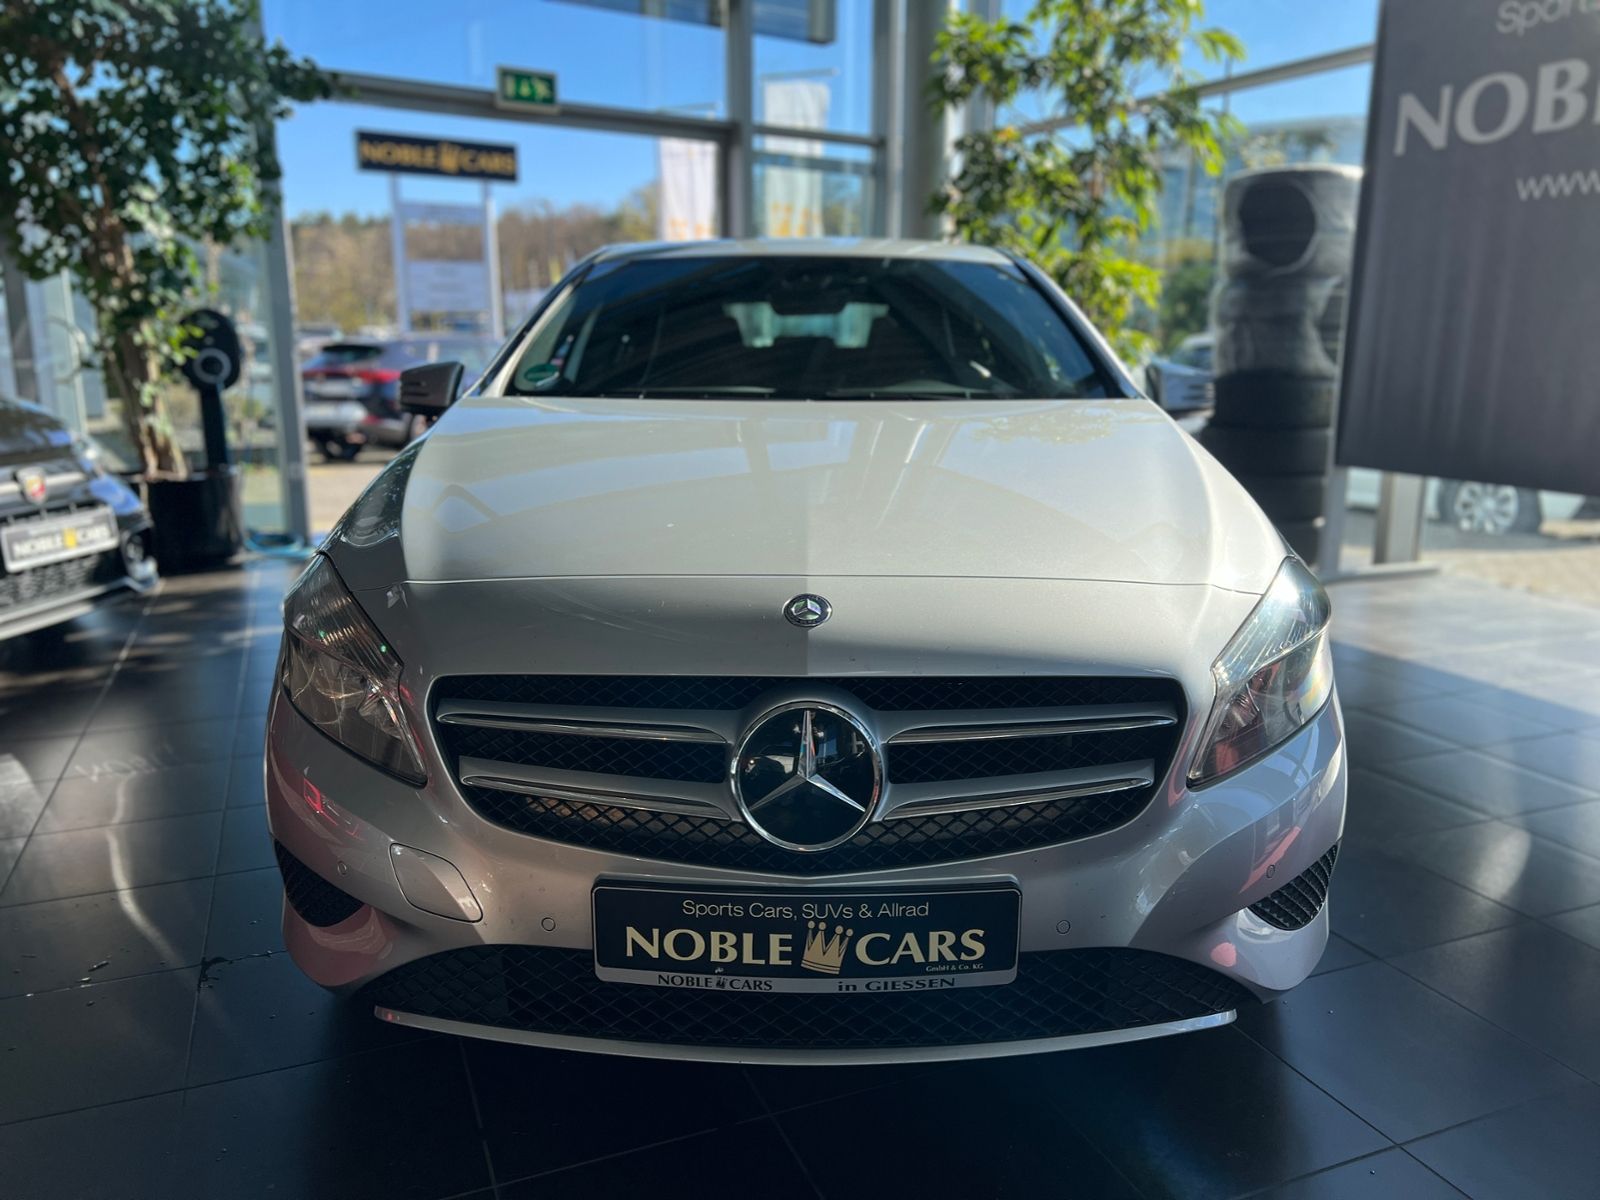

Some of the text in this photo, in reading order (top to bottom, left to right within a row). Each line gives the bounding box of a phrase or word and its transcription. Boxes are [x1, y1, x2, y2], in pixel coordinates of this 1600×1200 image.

[1394, 58, 1600, 156] NOB
[682, 900, 929, 921] Sports Cars, SUVs & Allrad
[626, 926, 986, 966] NOBLE CARS
[657, 974, 955, 992] NOBLE CARS in GIESSEN
